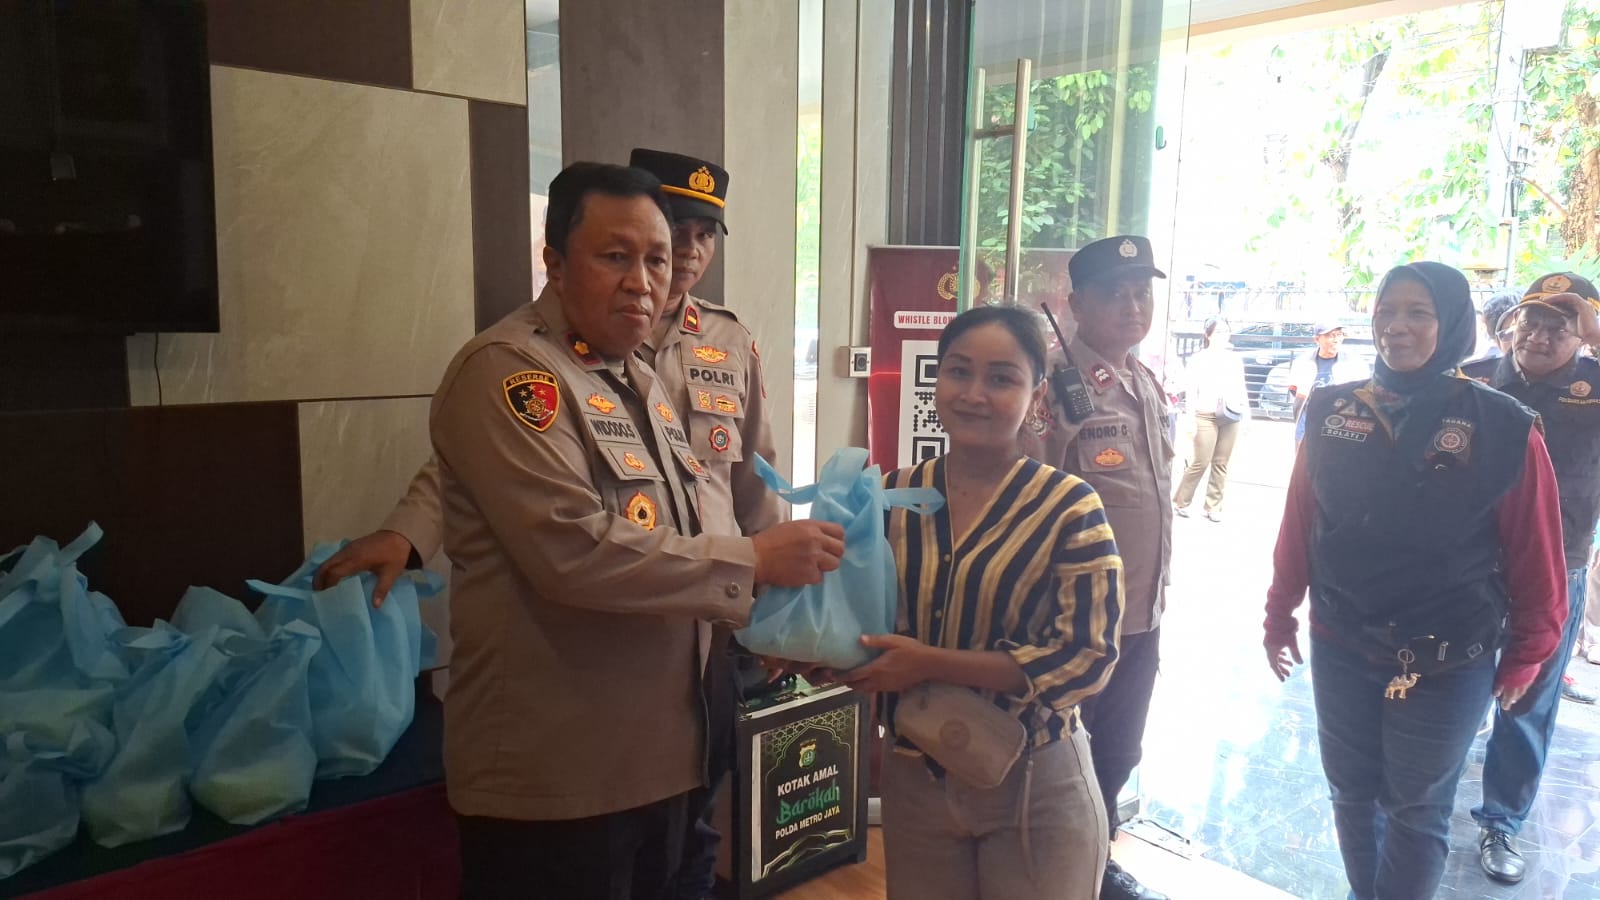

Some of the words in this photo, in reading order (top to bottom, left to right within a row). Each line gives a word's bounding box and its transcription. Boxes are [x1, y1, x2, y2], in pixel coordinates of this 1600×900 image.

[898, 315, 931, 325] WHISTLE
[689, 367, 735, 386] POLRI
[777, 774, 811, 797] KOTAK
[812, 764, 839, 784] AMAL
[775, 822, 799, 840] POLDA
[799, 812, 823, 830] METRO
[823, 805, 841, 819] JAYA
